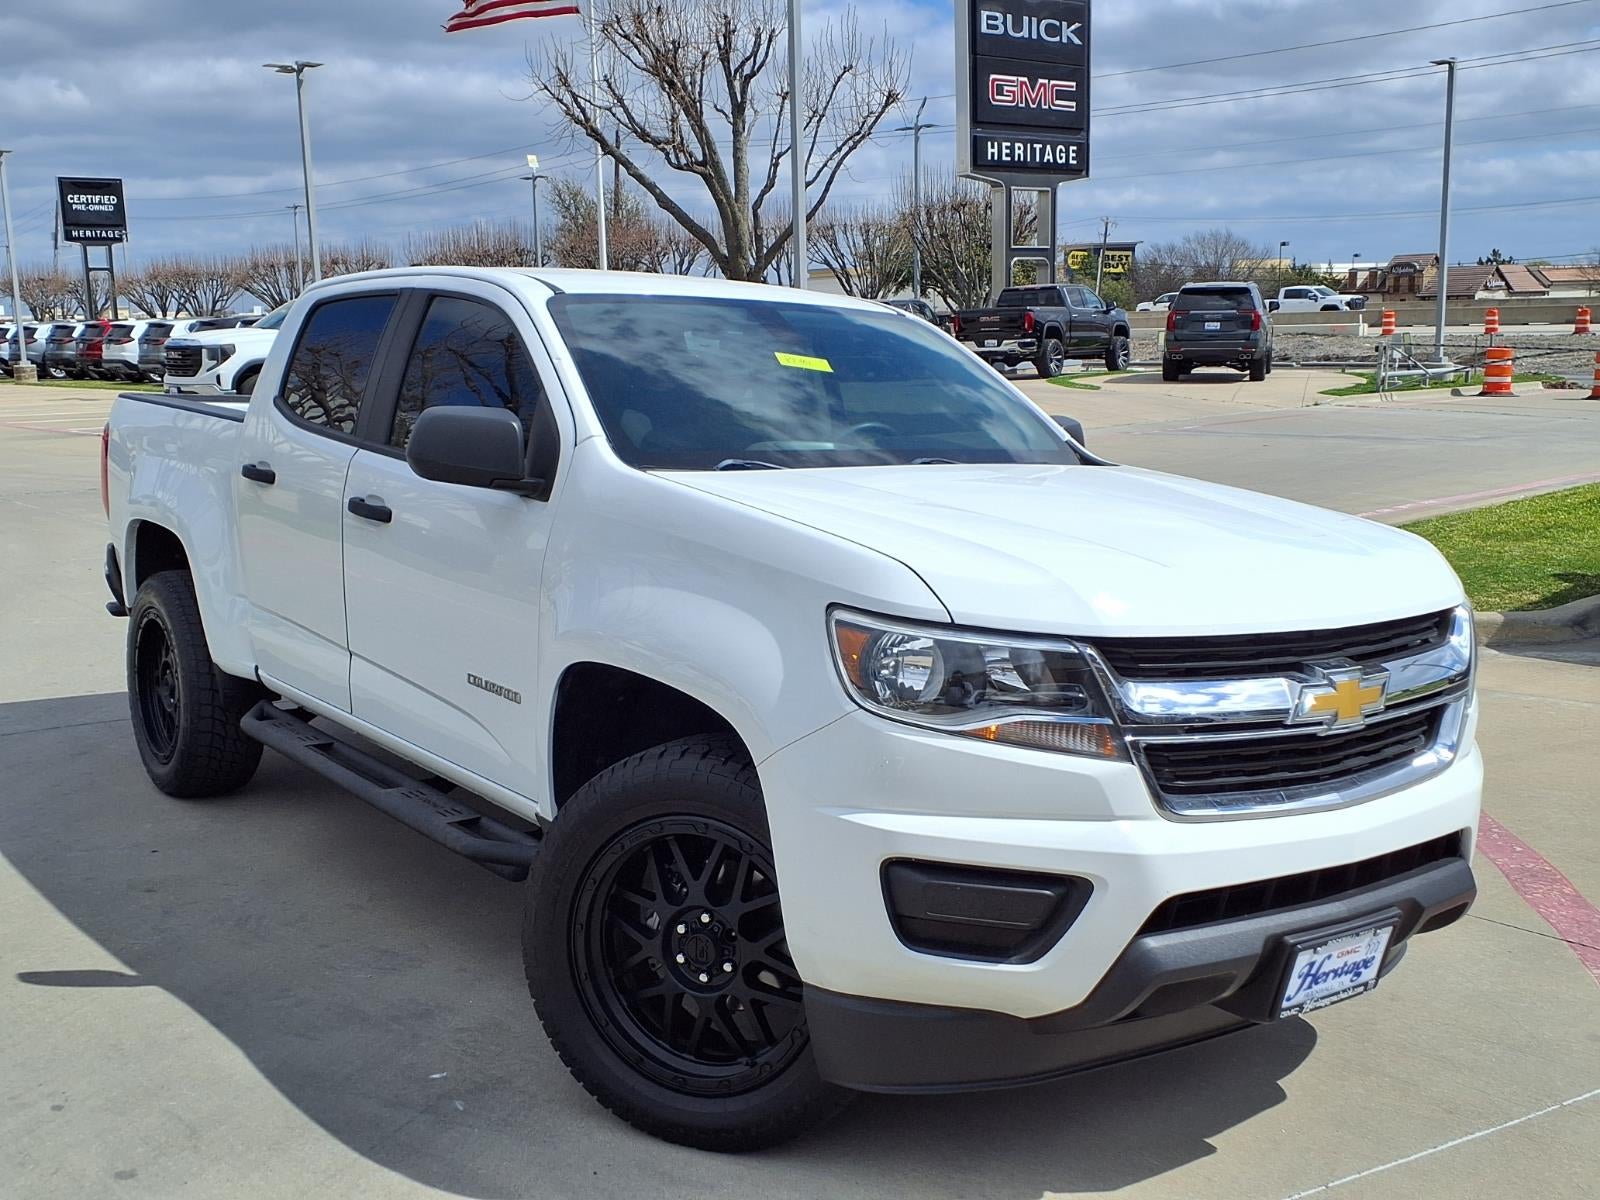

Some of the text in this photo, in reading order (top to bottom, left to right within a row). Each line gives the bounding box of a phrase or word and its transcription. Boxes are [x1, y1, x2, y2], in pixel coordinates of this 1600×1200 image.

[980, 10, 1083, 45] BUICK
[989, 74, 1077, 112] GMC
[987, 141, 1078, 164] HERITAGE
[67, 194, 117, 204] CERTIFIED
[72, 230, 121, 238] HERITAGE
[1104, 254, 1131, 262] BEST
[1104, 262, 1128, 270] BUY
[1336, 944, 1363, 959] GMC
[1285, 953, 1376, 1002] Heritage
